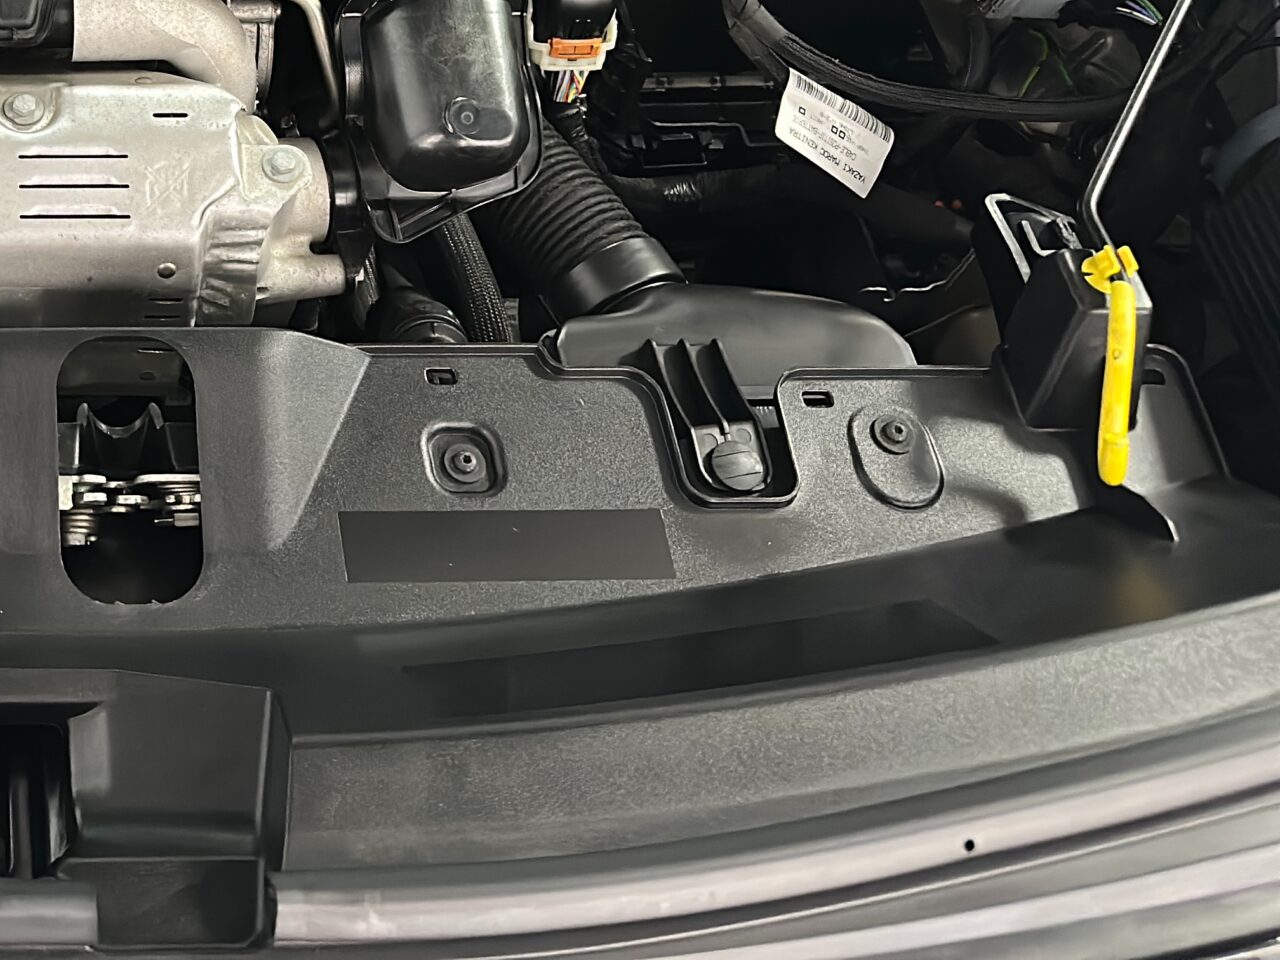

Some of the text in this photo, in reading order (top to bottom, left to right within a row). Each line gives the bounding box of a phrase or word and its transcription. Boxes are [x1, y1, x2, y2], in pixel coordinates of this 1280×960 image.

[789, 127, 818, 150] KENITRA
[820, 147, 841, 167] MAROC
[842, 163, 866, 184] YAZAKI
